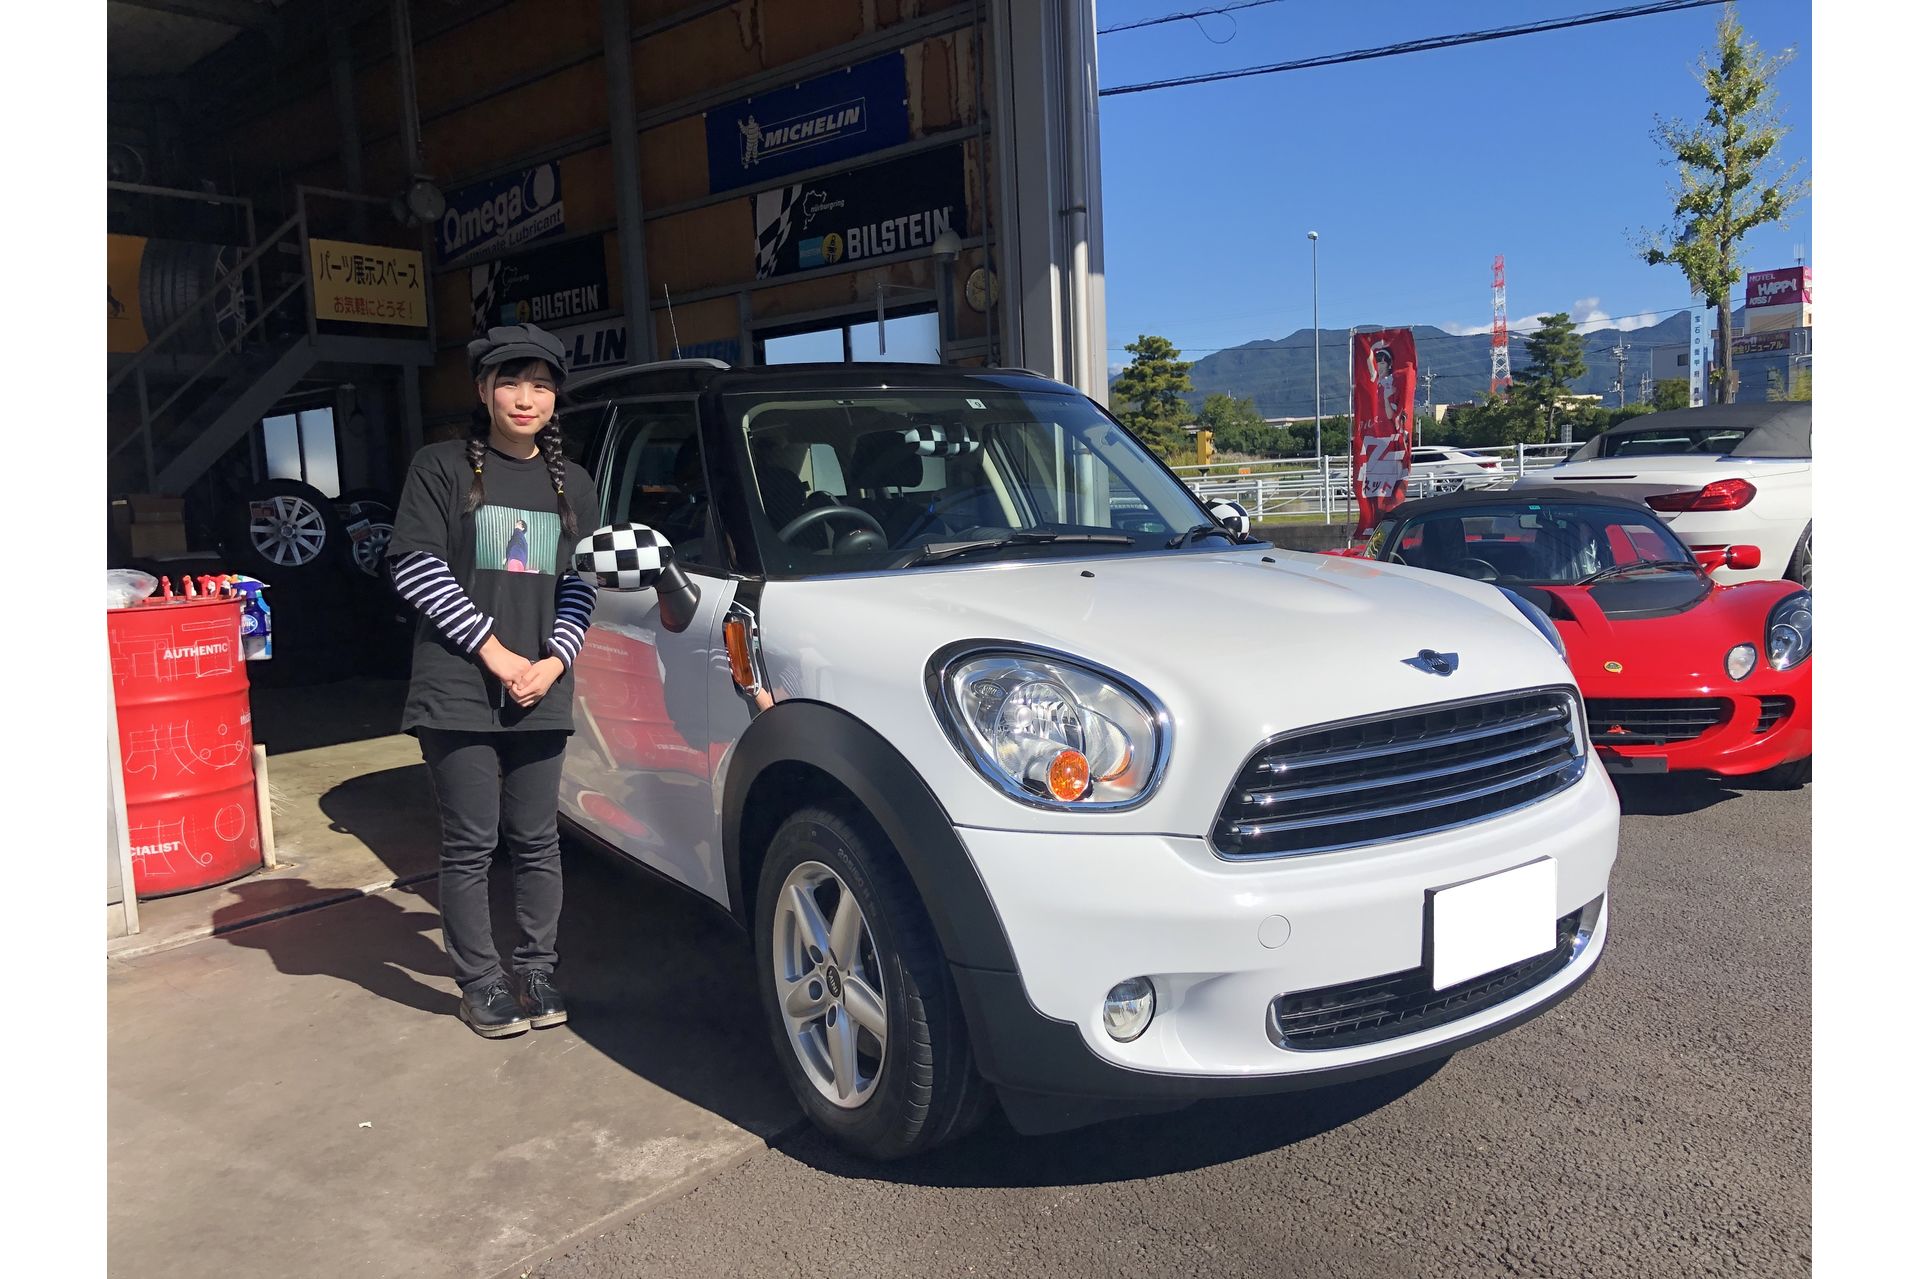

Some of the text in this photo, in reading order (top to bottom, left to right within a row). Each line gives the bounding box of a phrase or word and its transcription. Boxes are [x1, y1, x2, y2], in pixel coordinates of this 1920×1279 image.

[764, 106, 860, 148] MICHELIN
[508, 208, 561, 246] Lubricant
[320, 250, 419, 289] パーツ展示スペース
[1757, 278, 1797, 296] HAPPY
[532, 283, 600, 322] BILSTEIN
[163, 642, 229, 660] AUTHENTIC
[828, 969, 839, 993] MINI
